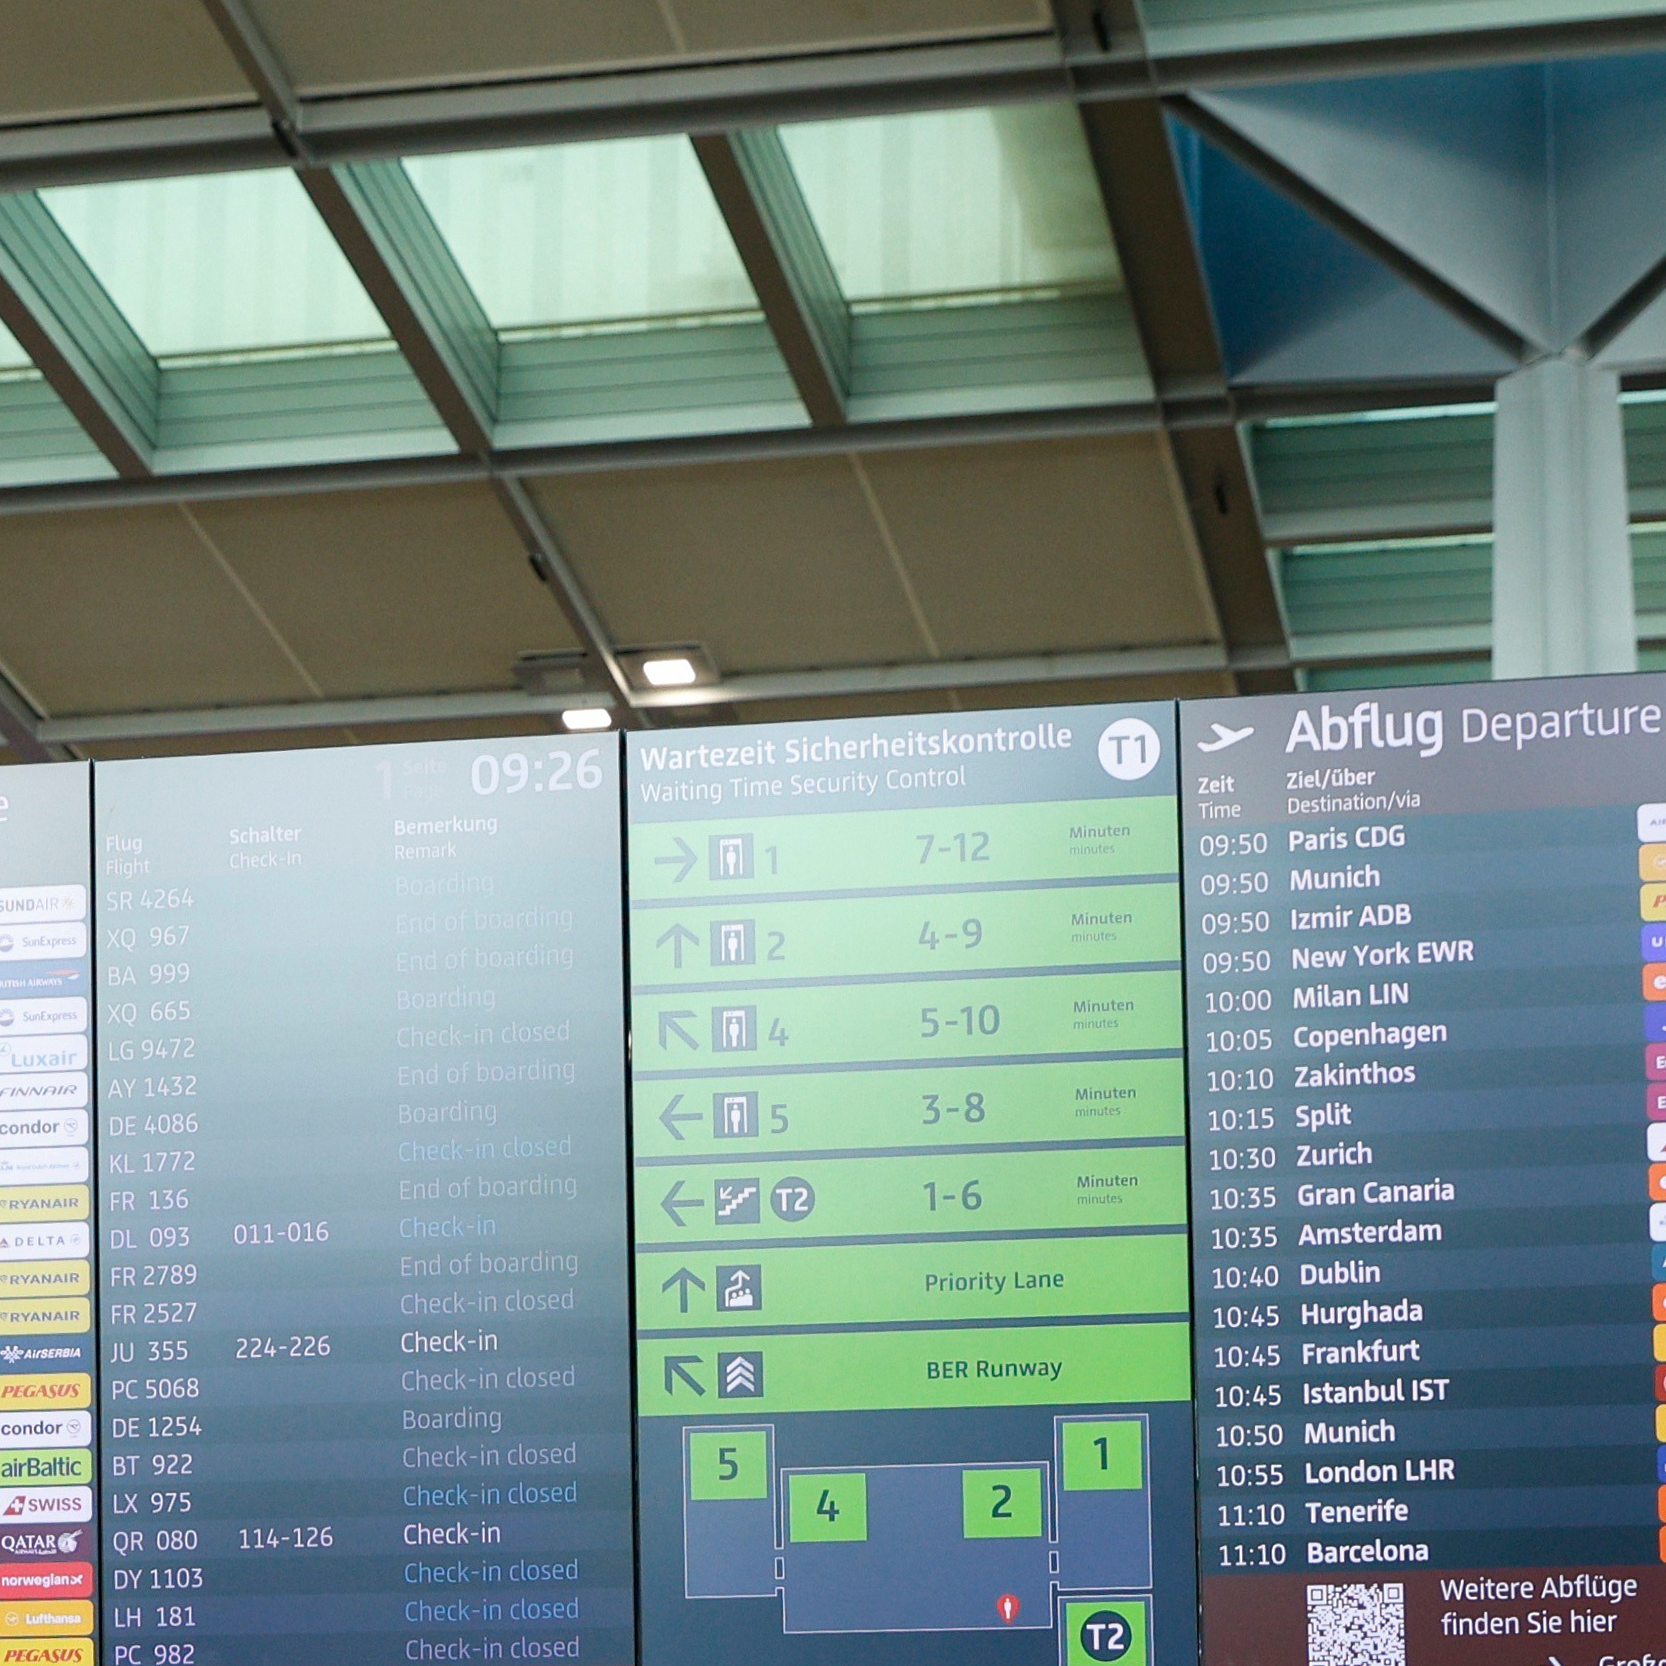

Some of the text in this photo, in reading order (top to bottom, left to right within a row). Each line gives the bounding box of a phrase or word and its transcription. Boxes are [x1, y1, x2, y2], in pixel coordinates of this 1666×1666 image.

[1286, 702, 1661, 757] Abflug Departure
[641, 723, 1073, 770] Wartezeit Sicherheitskontrolle
[1109, 735, 1146, 764] T1
[471, 748, 602, 795] 09:26
[641, 765, 965, 804] Waiting Time Security Control
[1070, 826, 1130, 838] Minuten
[1201, 825, 1404, 856] 09:50 Paris CDG
[765, 832, 989, 874] 1 7-12
[768, 918, 982, 960] 2 4-9
[769, 1005, 999, 1046] 4 5-10
[1207, 1022, 1446, 1052] 10:05 Copenhagen
[771, 1093, 985, 1133] 5 3-8
[776, 1180, 981, 1211] T2 1-6
[15, 1236, 64, 1246] DELTA
[235, 1222, 328, 1244] 011-016
[926, 1272, 1063, 1295] Priority Lane
[111, 1341, 187, 1362] JU 355
[237, 1336, 330, 1358] 224-226
[402, 1329, 497, 1352] Check-in
[928, 1361, 1062, 1381] BER Runway
[2, 1457, 81, 1477] airBaltic
[719, 1448, 738, 1480] 5
[1094, 1437, 1107, 1470] 1
[817, 1490, 839, 1521] 4
[992, 1485, 1012, 1517] 2
[1220, 1539, 1428, 1566] 11:10 Barcelona
[1441, 1574, 1637, 1603] Weitere Abflüge
[1086, 1623, 1124, 1650] T2
[1441, 1609, 1617, 1635] finden Sie hier
[4, 1649, 83, 1663] PEGASUS
[116, 1644, 194, 1665] PC 982
[407, 1636, 578, 1660] Check-in closed
